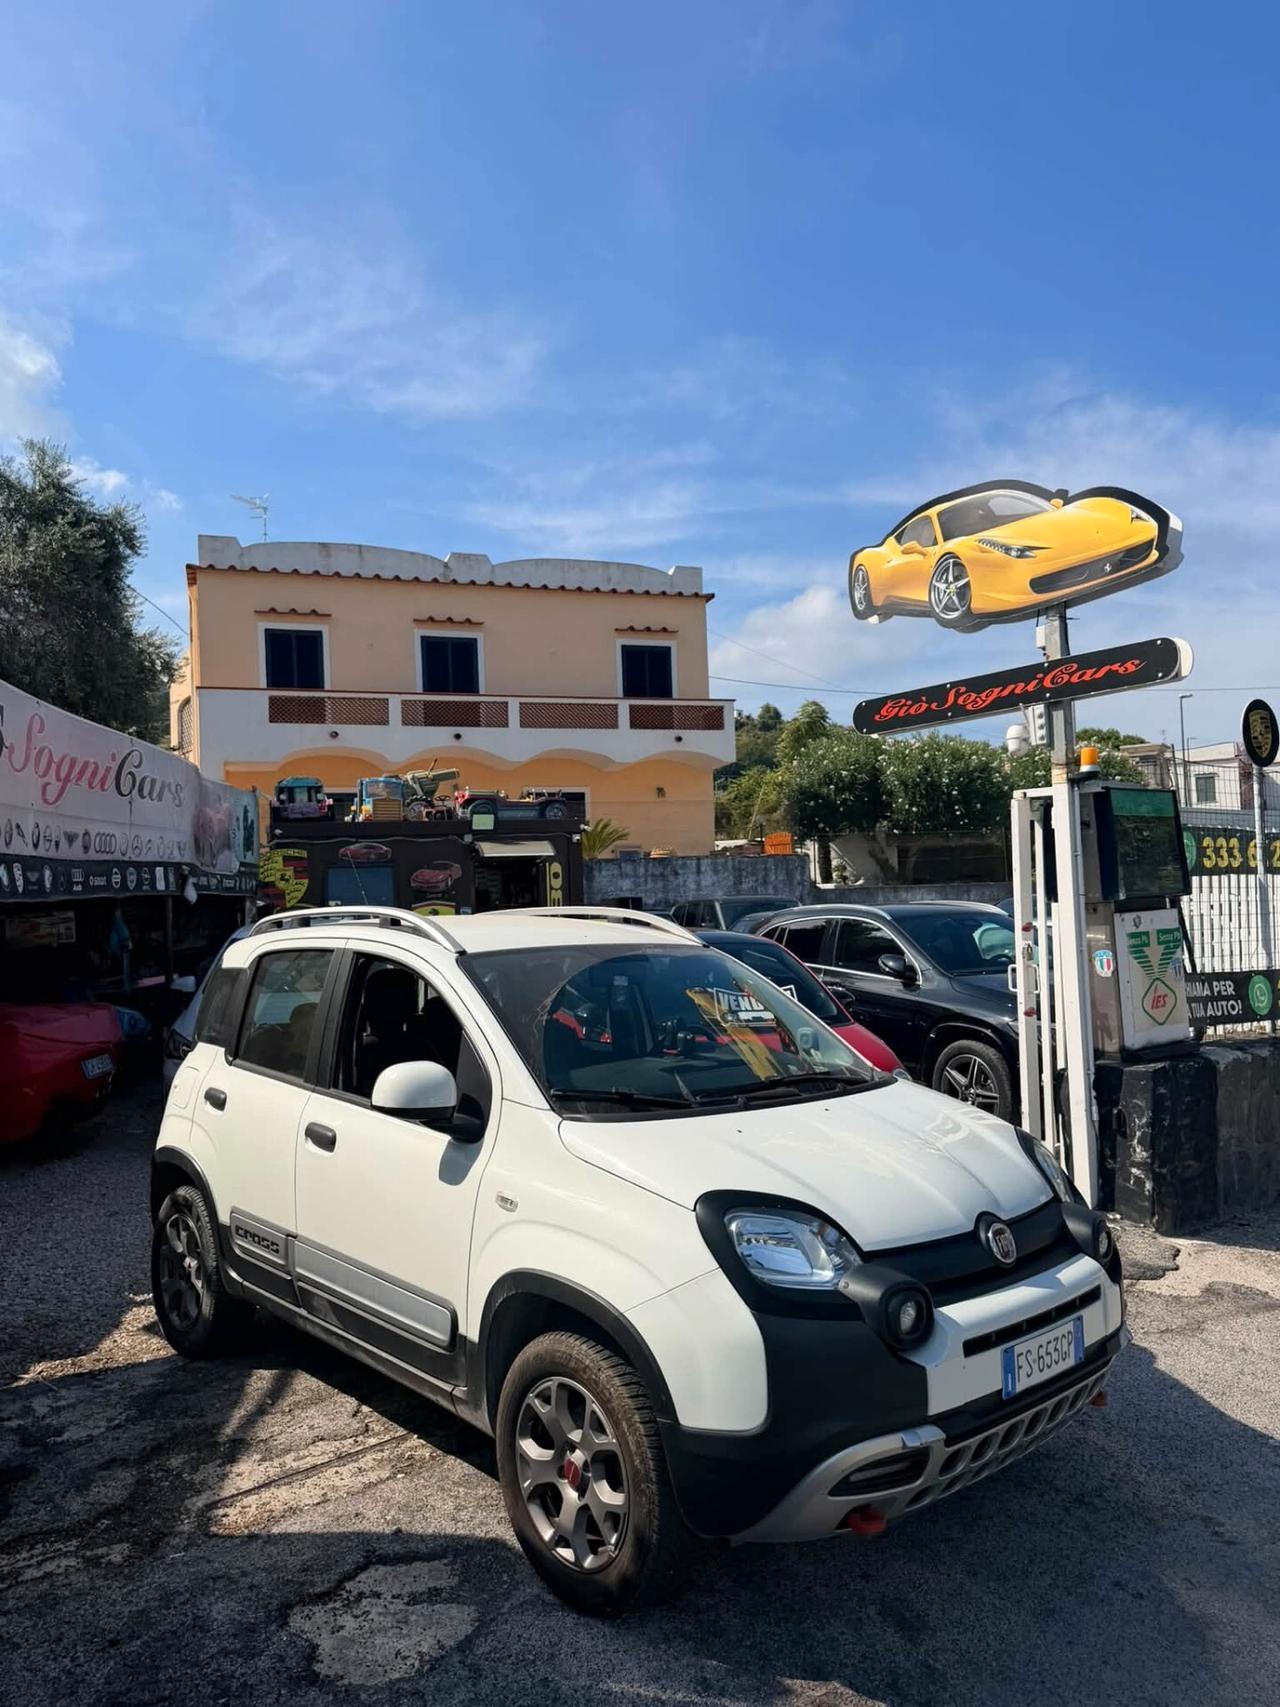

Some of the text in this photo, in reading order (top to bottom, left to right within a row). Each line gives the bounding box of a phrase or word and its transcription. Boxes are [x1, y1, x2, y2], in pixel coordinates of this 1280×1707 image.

[874, 697, 929, 721] Giò
[1203, 837, 1241, 868] 333
[1186, 981, 1235, 997] HIAMA PER
[1207, 1000, 1242, 1017] AUTO!
